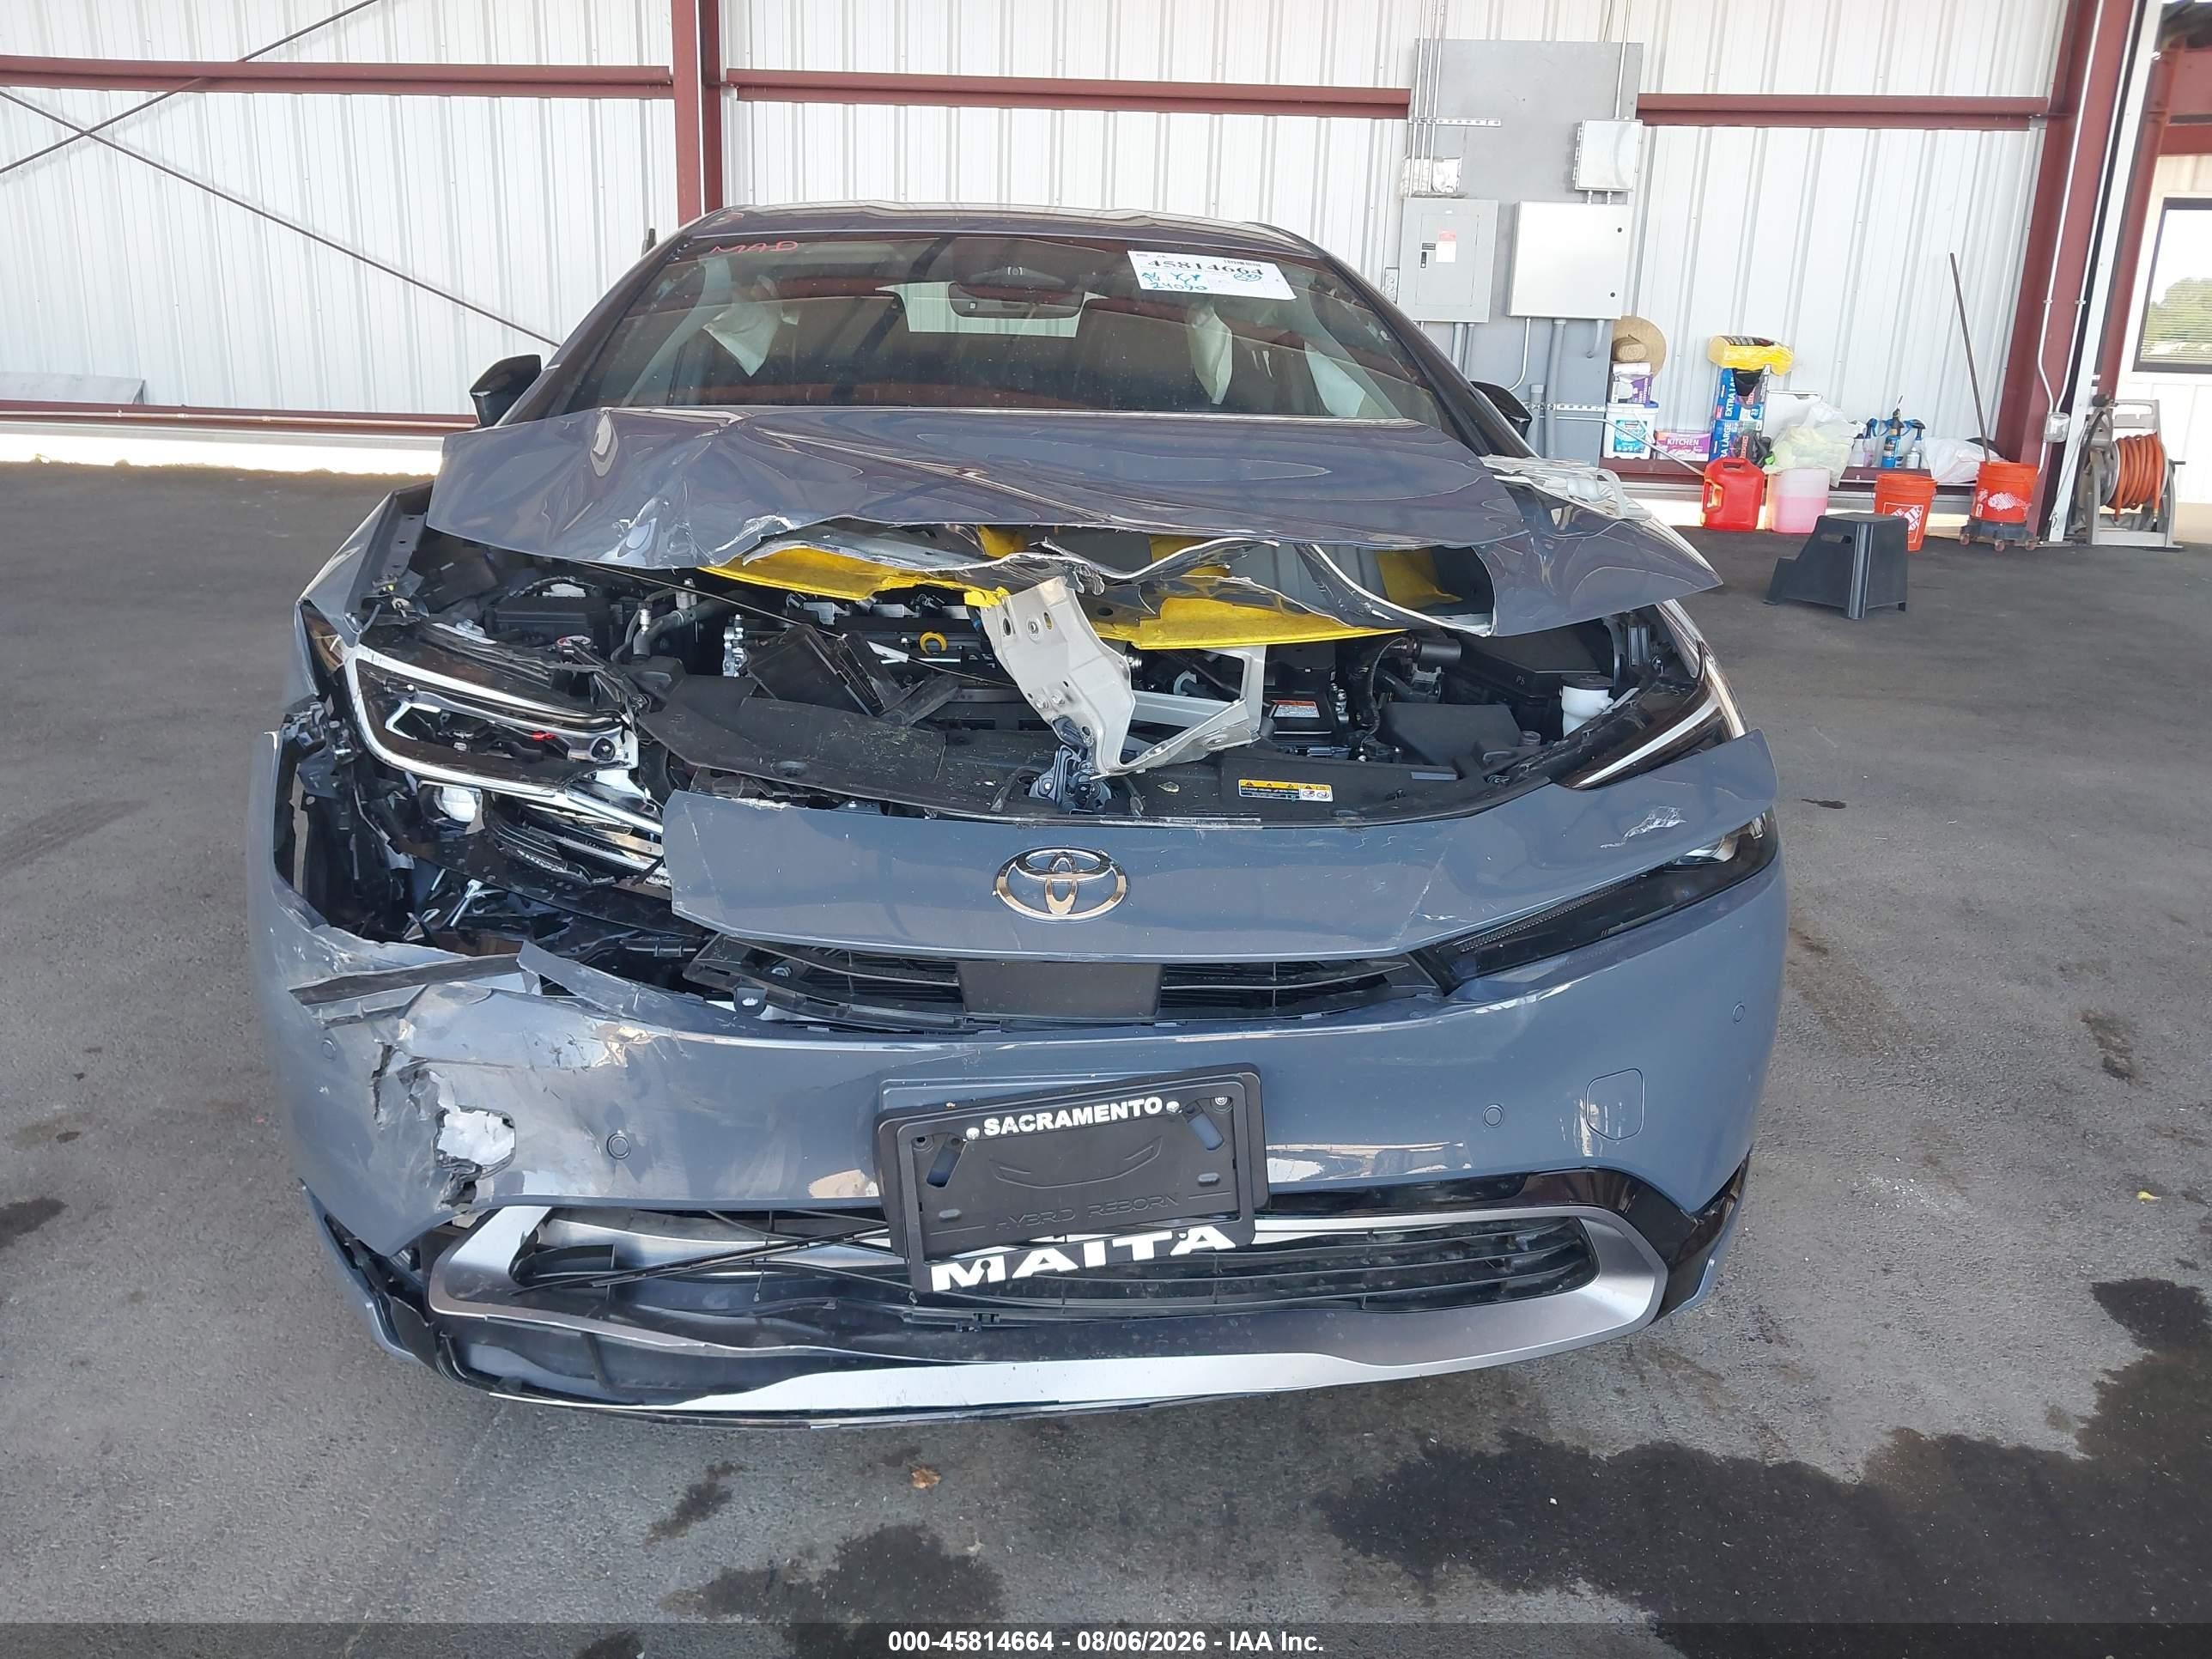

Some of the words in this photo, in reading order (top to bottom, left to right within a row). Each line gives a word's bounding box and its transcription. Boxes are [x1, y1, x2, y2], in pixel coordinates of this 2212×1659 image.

[1147, 260, 1264, 275] 45814664
[1720, 422, 1732, 447] LARGE
[984, 1097, 1163, 1136] SACRAMENTO
[1087, 1196, 1180, 1218] REBORN
[931, 1226, 1237, 1291] MAITA
